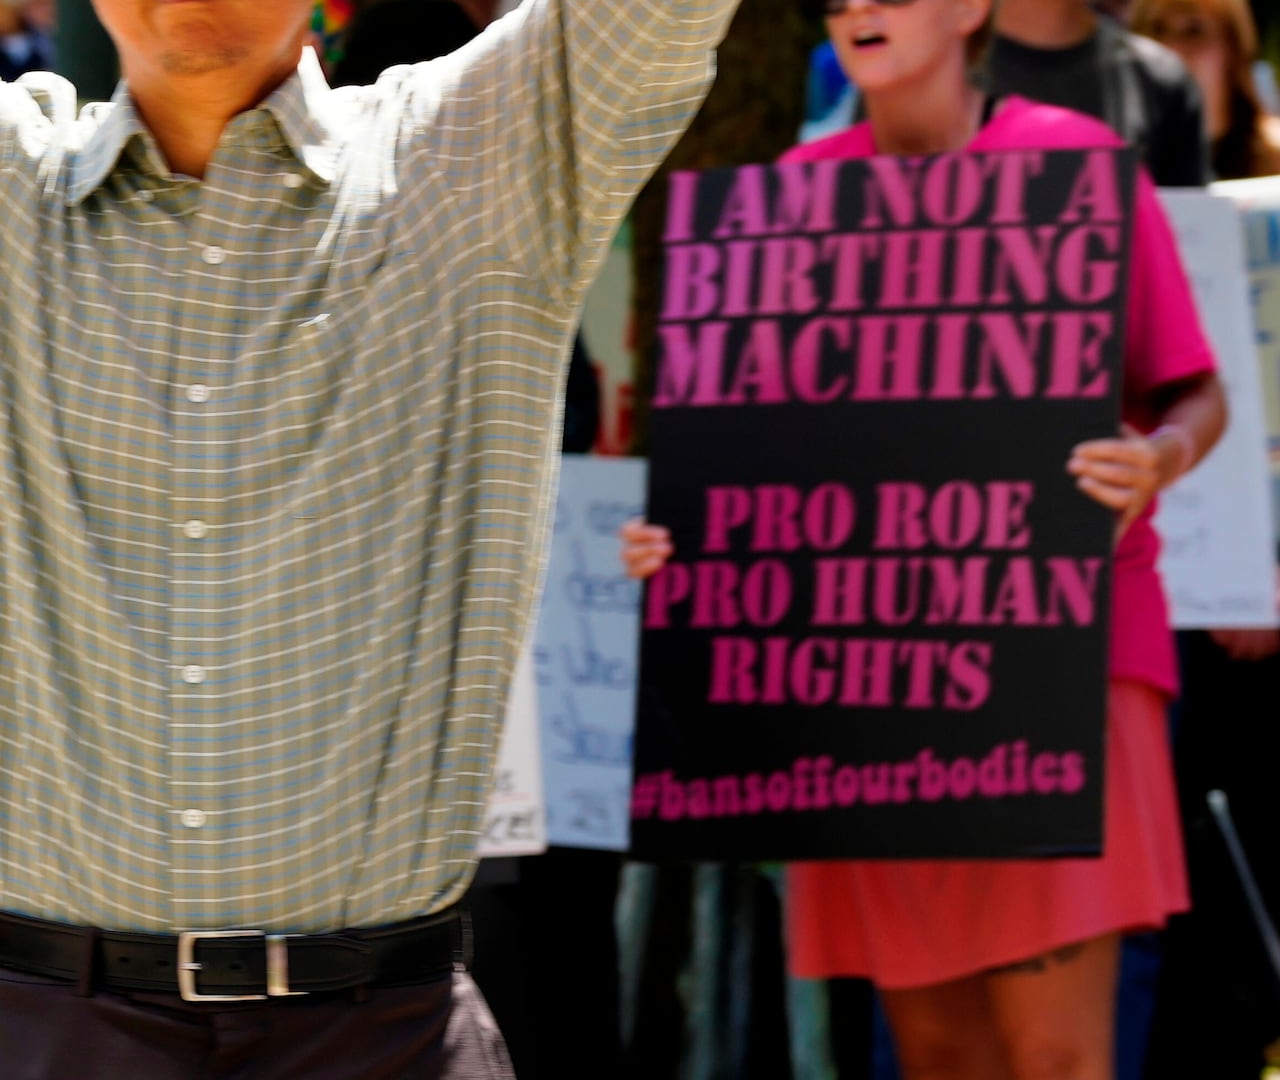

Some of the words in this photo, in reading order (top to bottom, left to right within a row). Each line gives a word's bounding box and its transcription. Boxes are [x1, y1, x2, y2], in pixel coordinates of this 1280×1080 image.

[664, 171, 697, 243] I
[714, 163, 838, 239] AM
[860, 151, 1042, 229] NOT
[1059, 150, 1122, 223] A
[658, 224, 1121, 320] BIRTHING
[652, 311, 1114, 407] MACHINE
[702, 483, 855, 554] PRO
[873, 481, 1034, 551] ROE
[644, 560, 793, 629] PRO
[811, 557, 1103, 628] HUMAN
[708, 637, 993, 710] RIGHTS
[630, 742, 1085, 820] #bansoffourbodies
